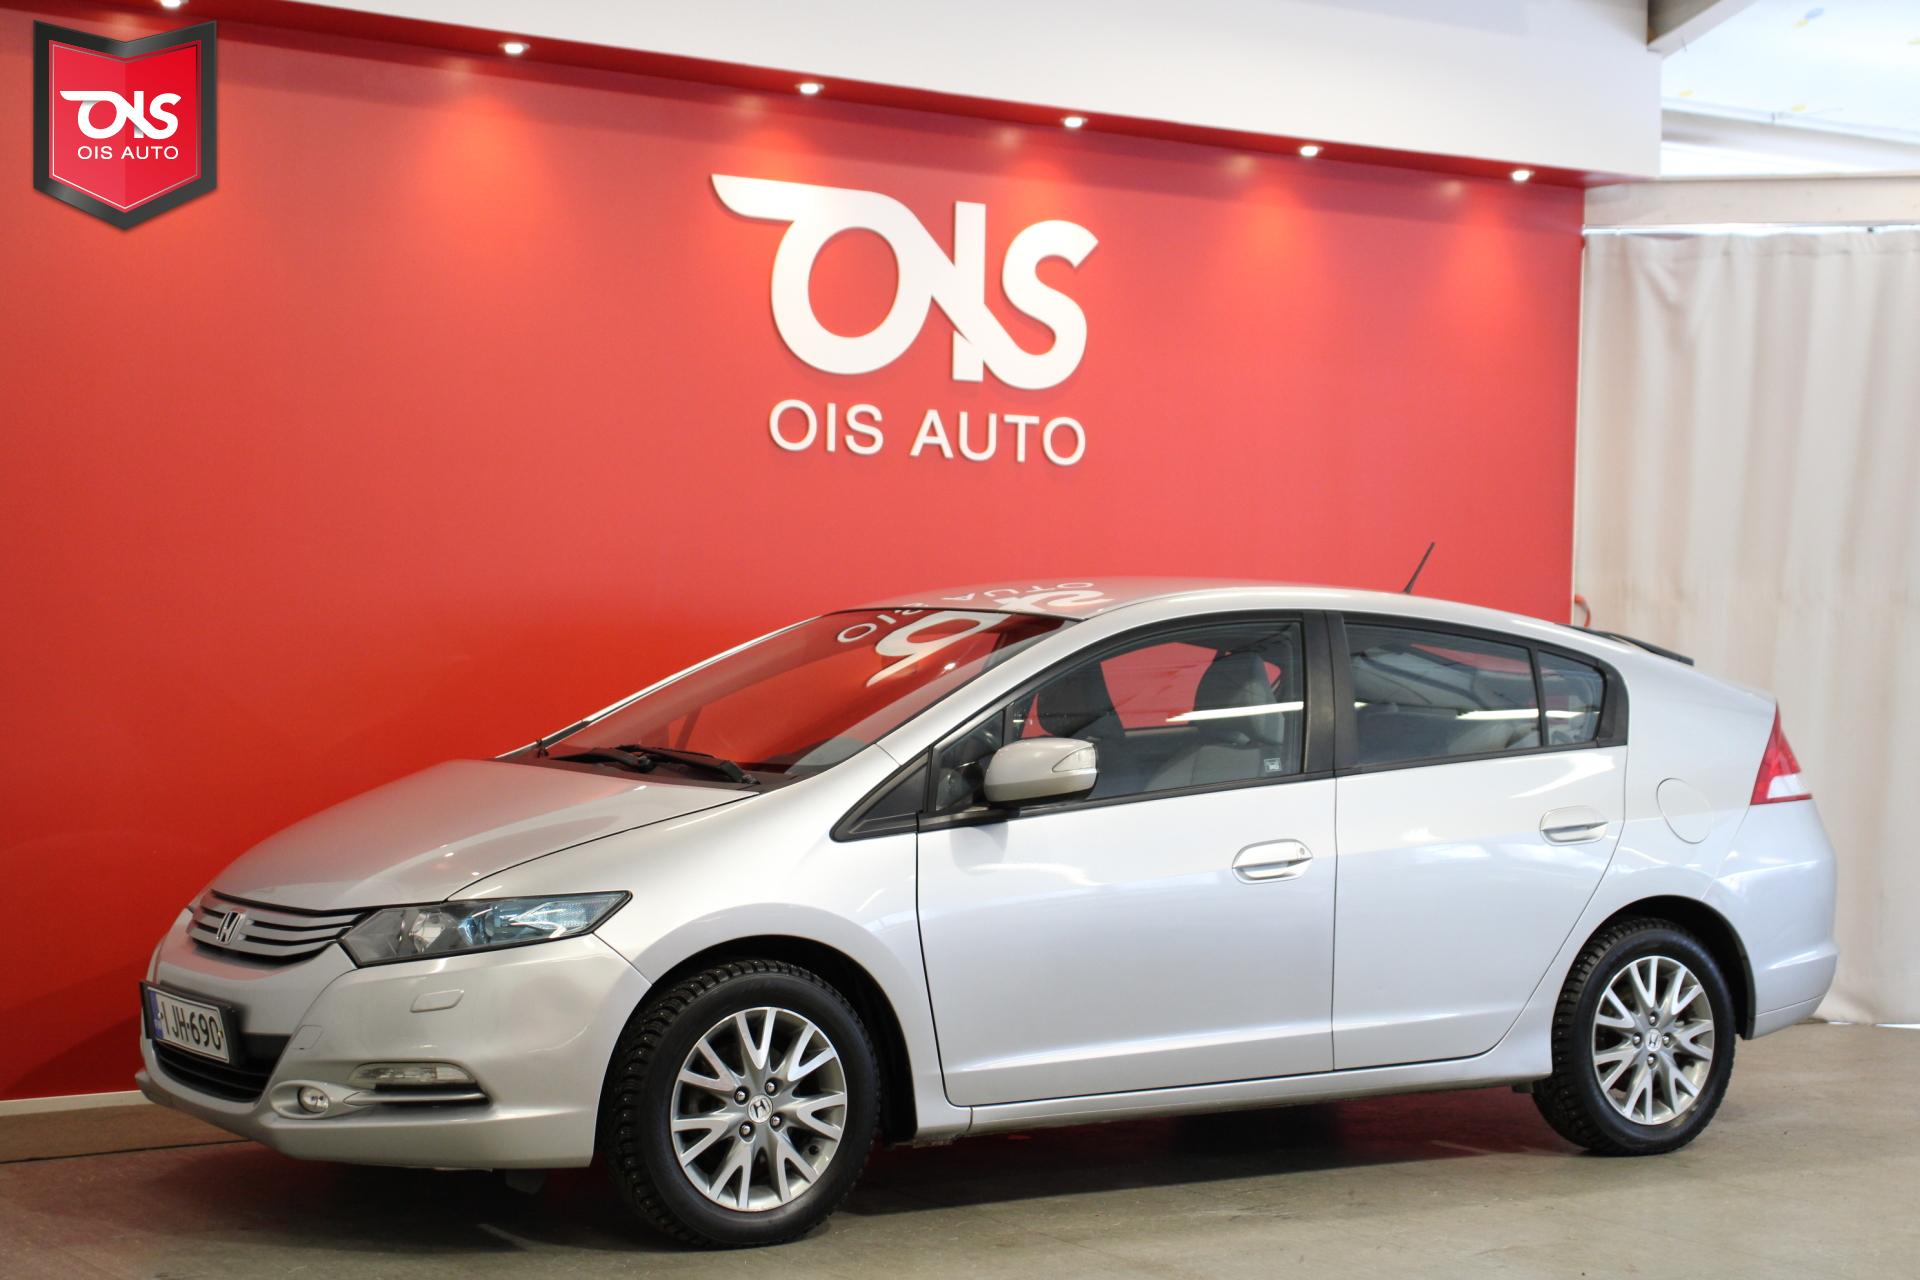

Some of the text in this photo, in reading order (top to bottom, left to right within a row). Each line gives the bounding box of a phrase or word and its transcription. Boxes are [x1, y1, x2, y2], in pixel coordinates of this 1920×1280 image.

[711, 173, 1099, 390] OIS
[769, 399, 1086, 466] OIS AUTO
